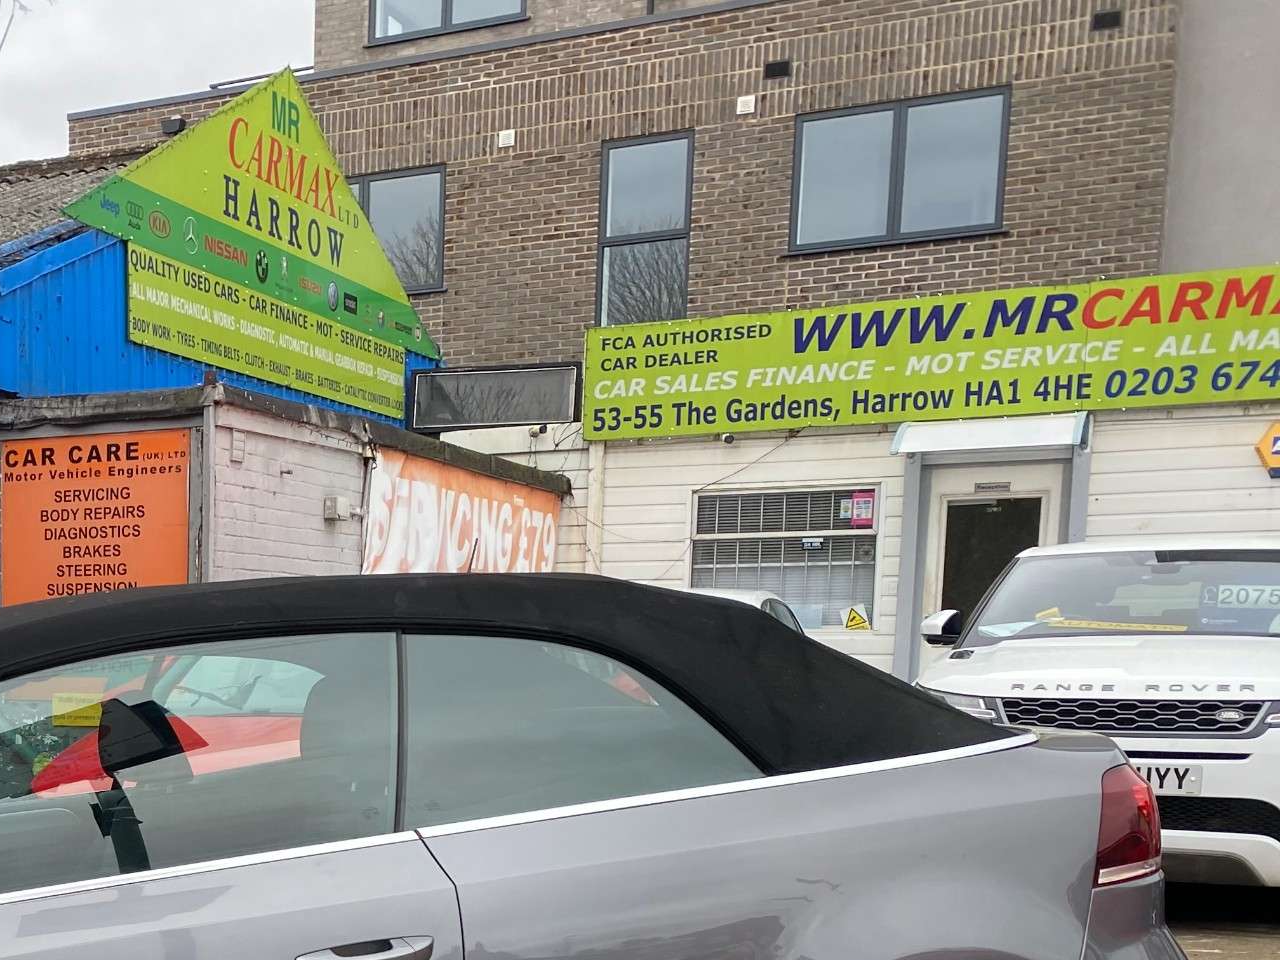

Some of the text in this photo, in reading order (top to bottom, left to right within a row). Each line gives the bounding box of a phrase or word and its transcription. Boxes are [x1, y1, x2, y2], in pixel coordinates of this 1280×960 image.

[272, 91, 300, 143] MR
[229, 117, 359, 229] CARMAX LTD
[152, 215, 168, 235] KIA
[223, 174, 344, 268] HARROW
[204, 235, 248, 267] NISSAN
[130, 249, 404, 364] QUALITY USED CARS CAR FINANCE MOT SERVICE REPAIRS
[132, 282, 145, 300] ALL
[146, 287, 169, 308] MAJOR
[171, 295, 211, 323] MECHANICAL
[213, 310, 235, 330] WORKS
[793, 274, 1280, 354] WWW.MRCARM
[133, 317, 150, 334] BODY
[152, 324, 170, 341] WORK
[177, 331, 195, 348] TYRES
[201, 338, 222, 357] TIMING
[224, 346, 239, 361] BELTS
[245, 353, 264, 368] CLUTCH
[269, 360, 290, 377] EXHAUST
[296, 369, 313, 384] BRAKES
[601, 323, 772, 351] FCA AUTHORISED
[594, 379, 646, 399] CAR
[653, 369, 738, 396] SALES
[745, 358, 875, 389] FINANCE
[904, 352, 975, 376] MOT
[981, 339, 1123, 370] SERVICE
[1155, 333, 1216, 358] ALL
[601, 349, 718, 372] CAR DEALER
[592, 403, 663, 432] 53-55
[672, 400, 717, 426] The
[725, 394, 841, 422] Gardens,
[852, 386, 954, 415] Harrow
[965, 378, 1021, 407] HA1
[1034, 373, 1092, 402] 4HE
[1105, 365, 1199, 398] 0203
[5, 442, 186, 468] CAR CARE (UK) LTD
[4, 463, 182, 482] Motor Vehicle Engineers
[54, 487, 131, 503] SERVICING
[40, 505, 145, 522] BODY REPAIRS
[44, 524, 141, 541] DIAGNOSTICS
[63, 544, 121, 559] BRAKES
[56, 563, 127, 577] STEERING
[1011, 684, 1255, 692] RANGE ROVER
